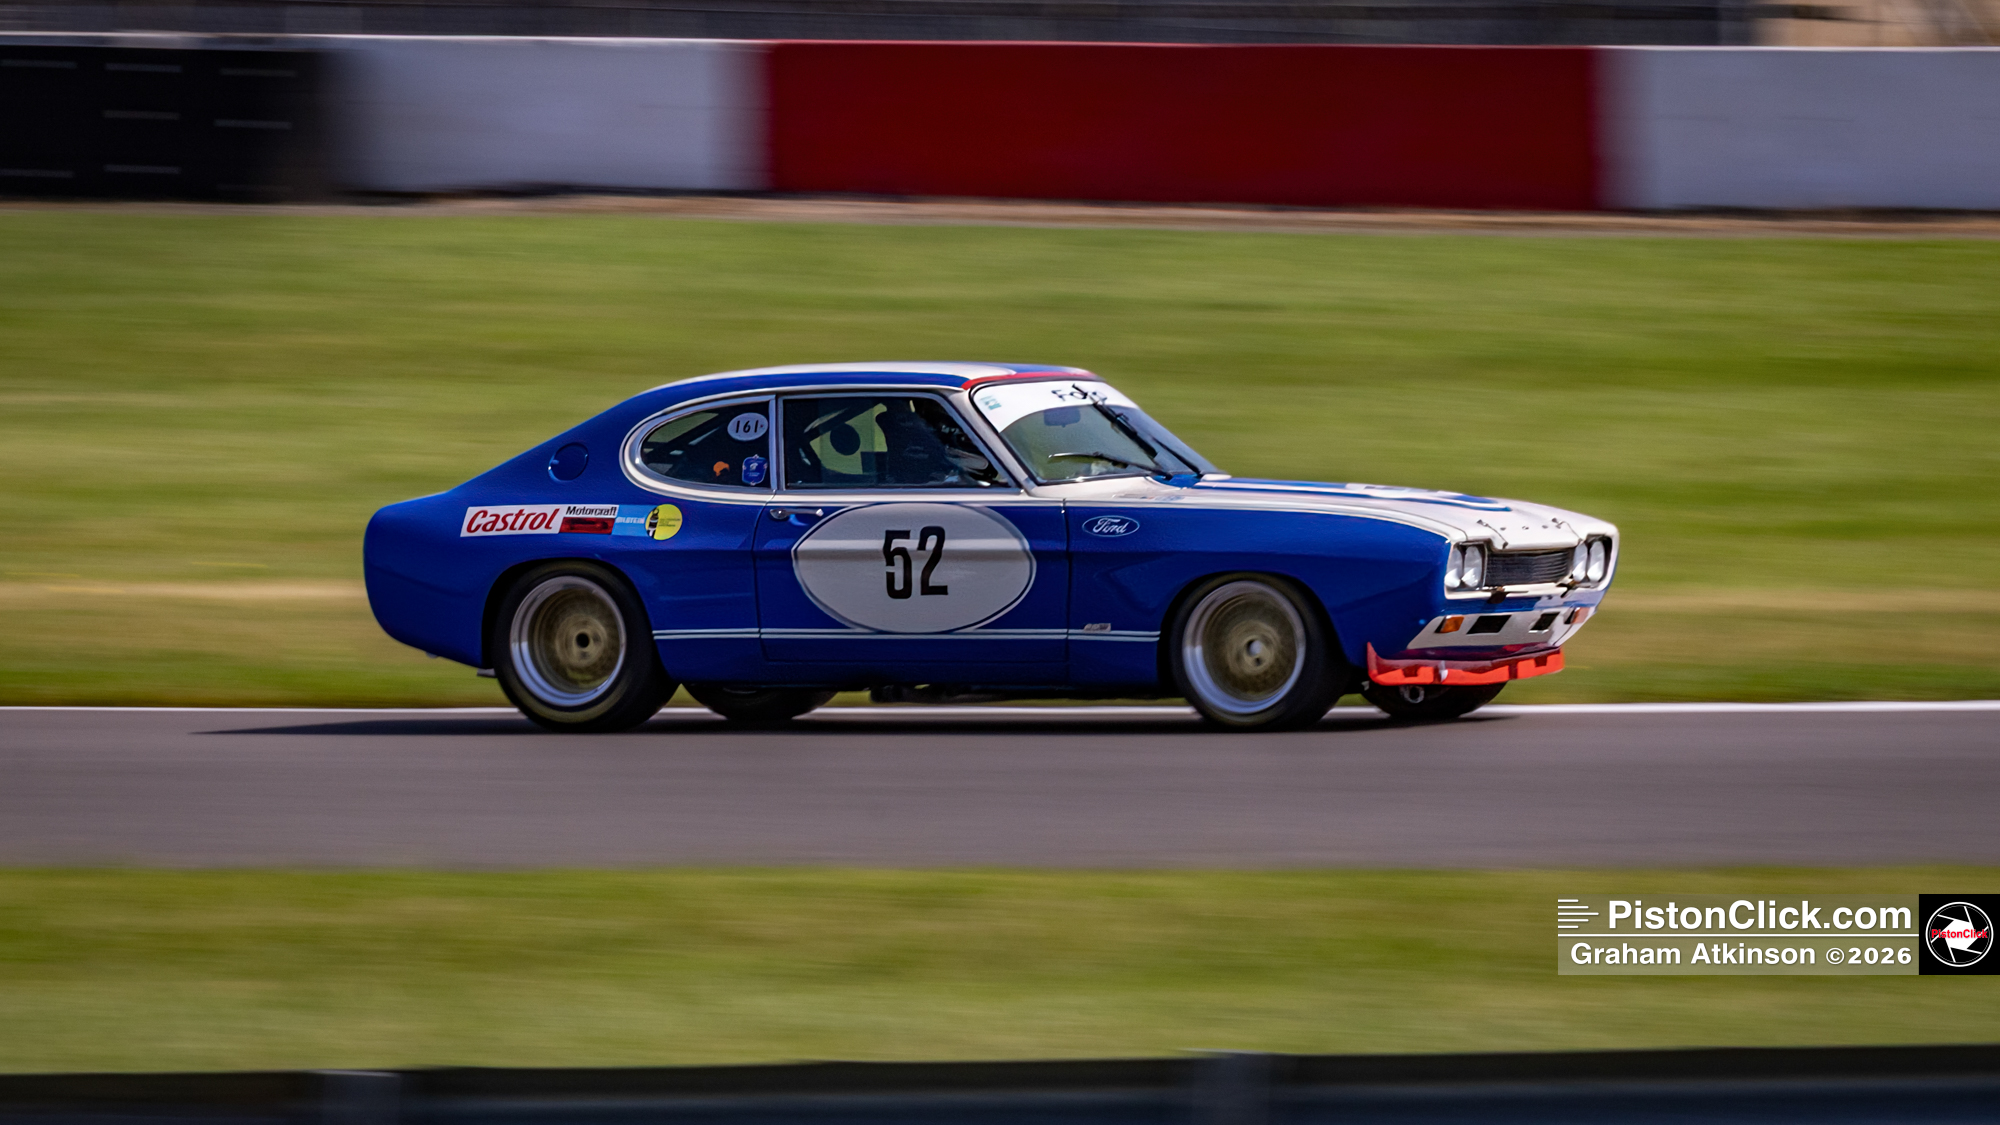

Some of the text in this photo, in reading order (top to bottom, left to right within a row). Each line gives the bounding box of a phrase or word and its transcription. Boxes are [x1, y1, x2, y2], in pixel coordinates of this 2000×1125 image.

[735, 420, 759, 433] 161
[565, 506, 617, 516] Motorcraft
[466, 508, 561, 533] Castrol
[1093, 517, 1130, 534] Ford
[883, 526, 949, 600] 52
